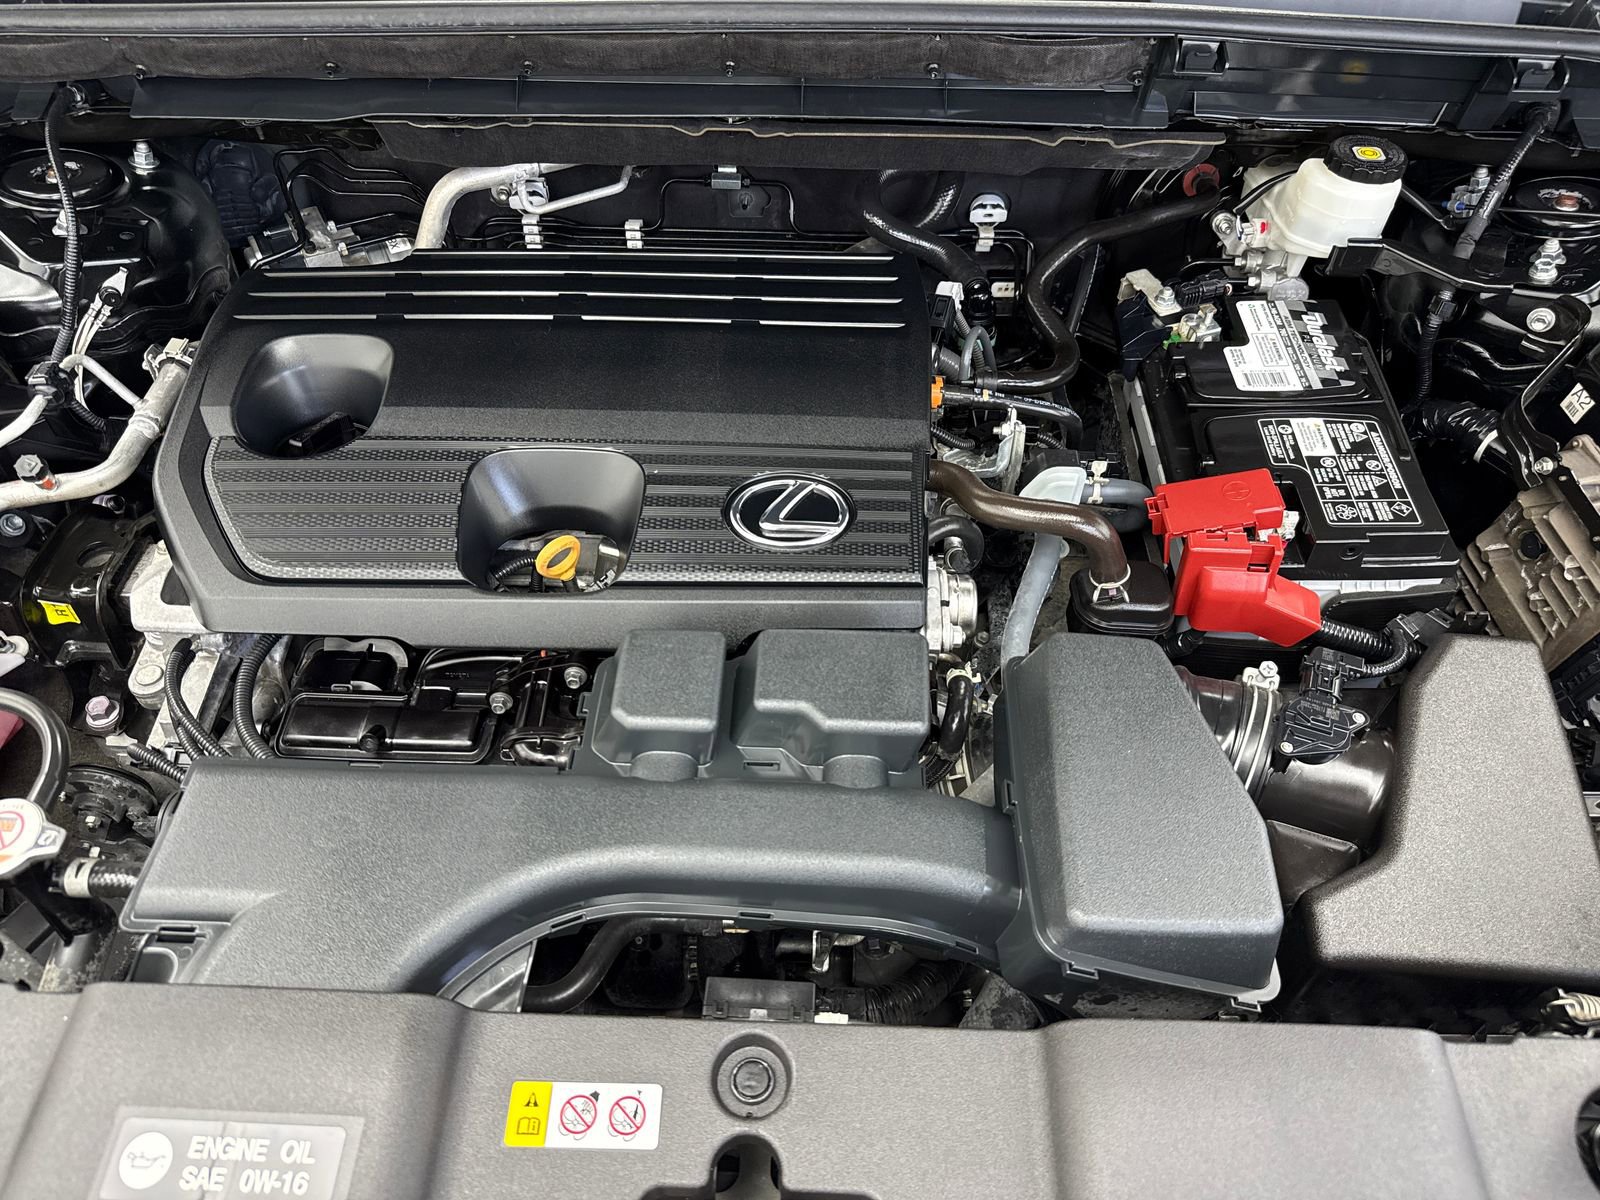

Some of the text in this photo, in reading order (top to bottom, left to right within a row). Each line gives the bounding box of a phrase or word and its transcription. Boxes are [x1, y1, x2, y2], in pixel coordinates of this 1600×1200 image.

[1290, 330, 1311, 368] TECHNOLOGY
[1301, 312, 1345, 372] Duralast
[1301, 334, 1322, 369] PLATINUM
[1571, 388, 1592, 411] A2
[187, 1135, 316, 1164] ENGINE OIL
[179, 1165, 310, 1196] SAE 0W-16
